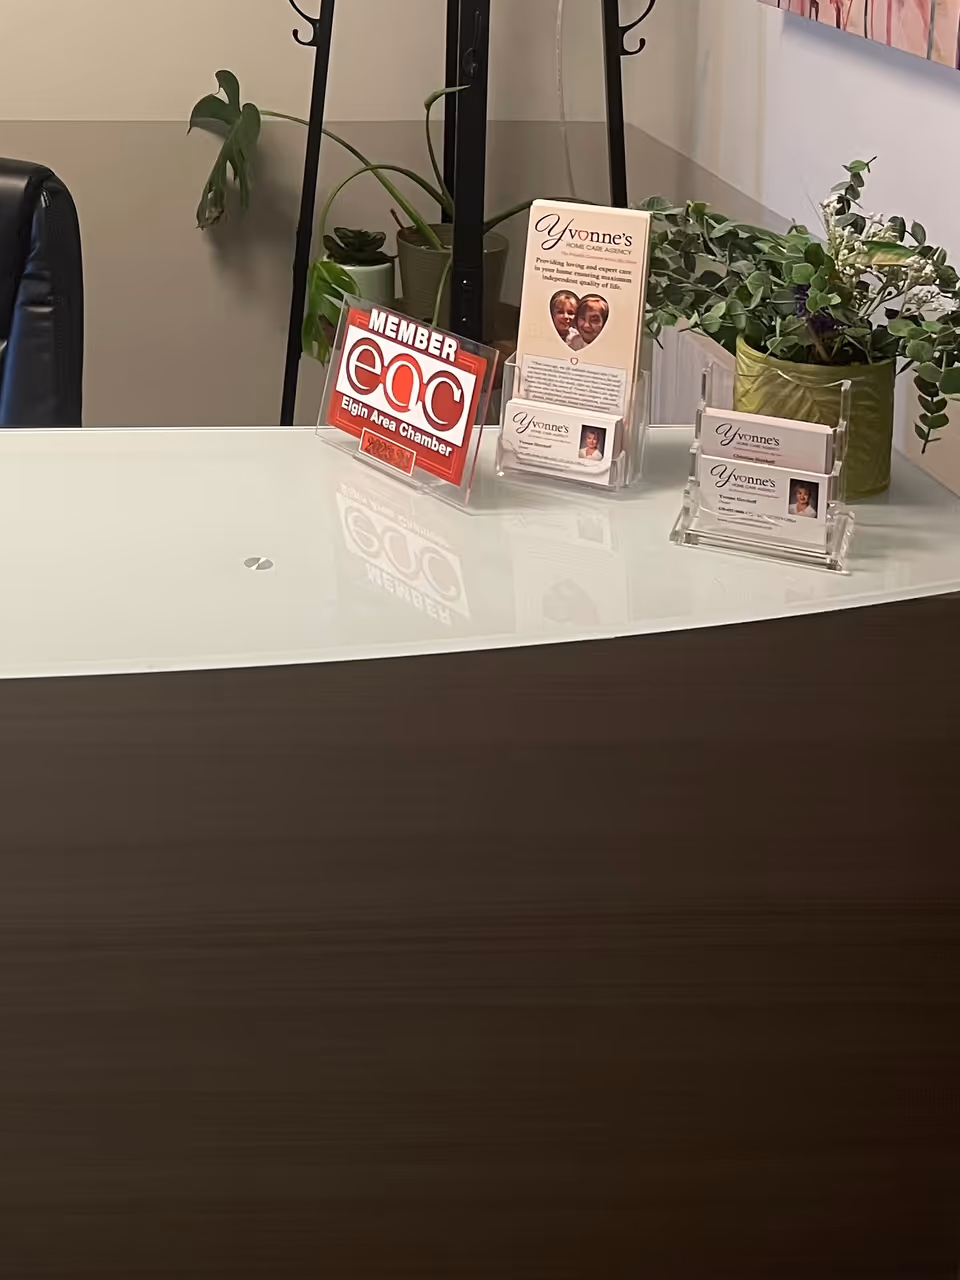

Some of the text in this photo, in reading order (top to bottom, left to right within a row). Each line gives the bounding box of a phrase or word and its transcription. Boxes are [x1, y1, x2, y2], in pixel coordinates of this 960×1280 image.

[535, 214, 633, 251] Yvonne's
[566, 242, 632, 256] HOME CARE AGENCY
[536, 257, 565, 267] Providing
[566, 260, 585, 270] loving
[586, 263, 597, 271] and
[598, 265, 618, 274] expert
[556, 268, 573, 276] home
[579, 279, 600, 288] quality
[368, 308, 458, 362] MEMBER
[347, 337, 464, 431] eac
[341, 395, 452, 457] Elgin Area Chamber
[513, 411, 569, 434] Yvonne's
[715, 423, 780, 446] Yvonne's
[710, 464, 776, 488] Yvonne's
